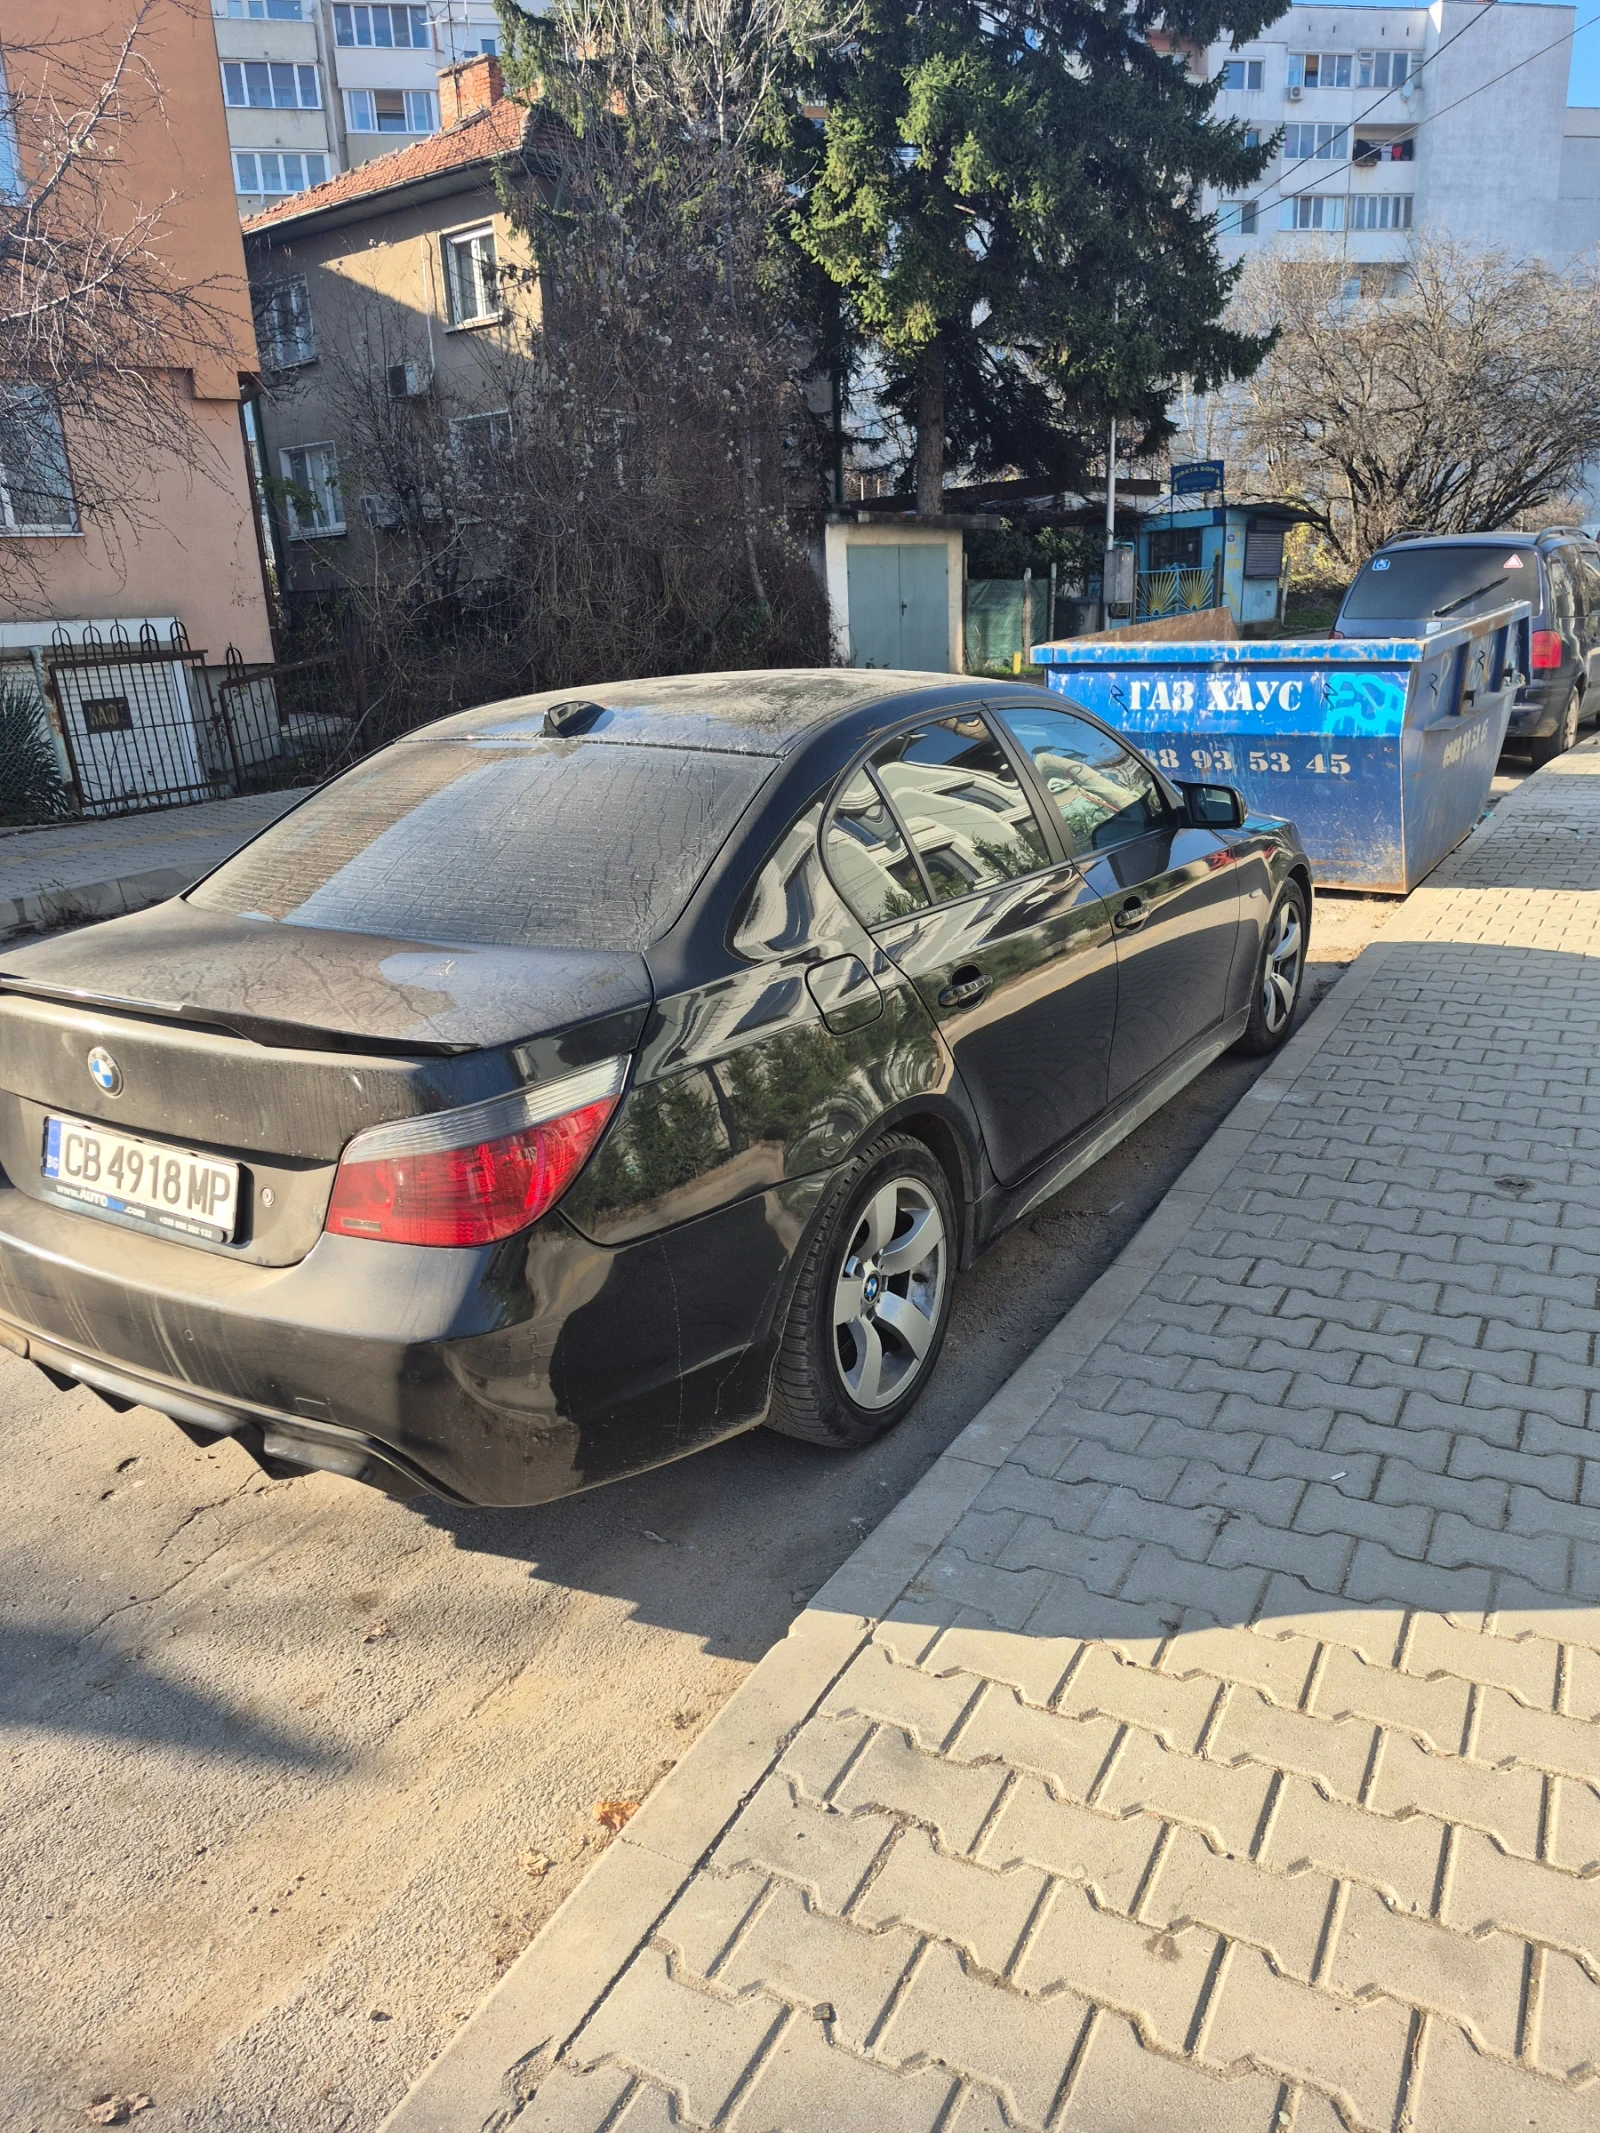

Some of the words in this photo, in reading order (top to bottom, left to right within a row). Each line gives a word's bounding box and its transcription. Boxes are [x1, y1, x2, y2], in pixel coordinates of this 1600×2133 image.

[1200, 466, 1220, 475] БОРА
[1130, 681, 1194, 711] ГАЗ
[1207, 680, 1302, 711] ХАУС
[1192, 750, 1233, 770] 93
[1249, 751, 1291, 772] 53
[1306, 753, 1351, 774] 45
[46, 1155, 59, 1170] BG
[107, 1145, 181, 1205] 4918
[187, 1164, 231, 1216] MP
